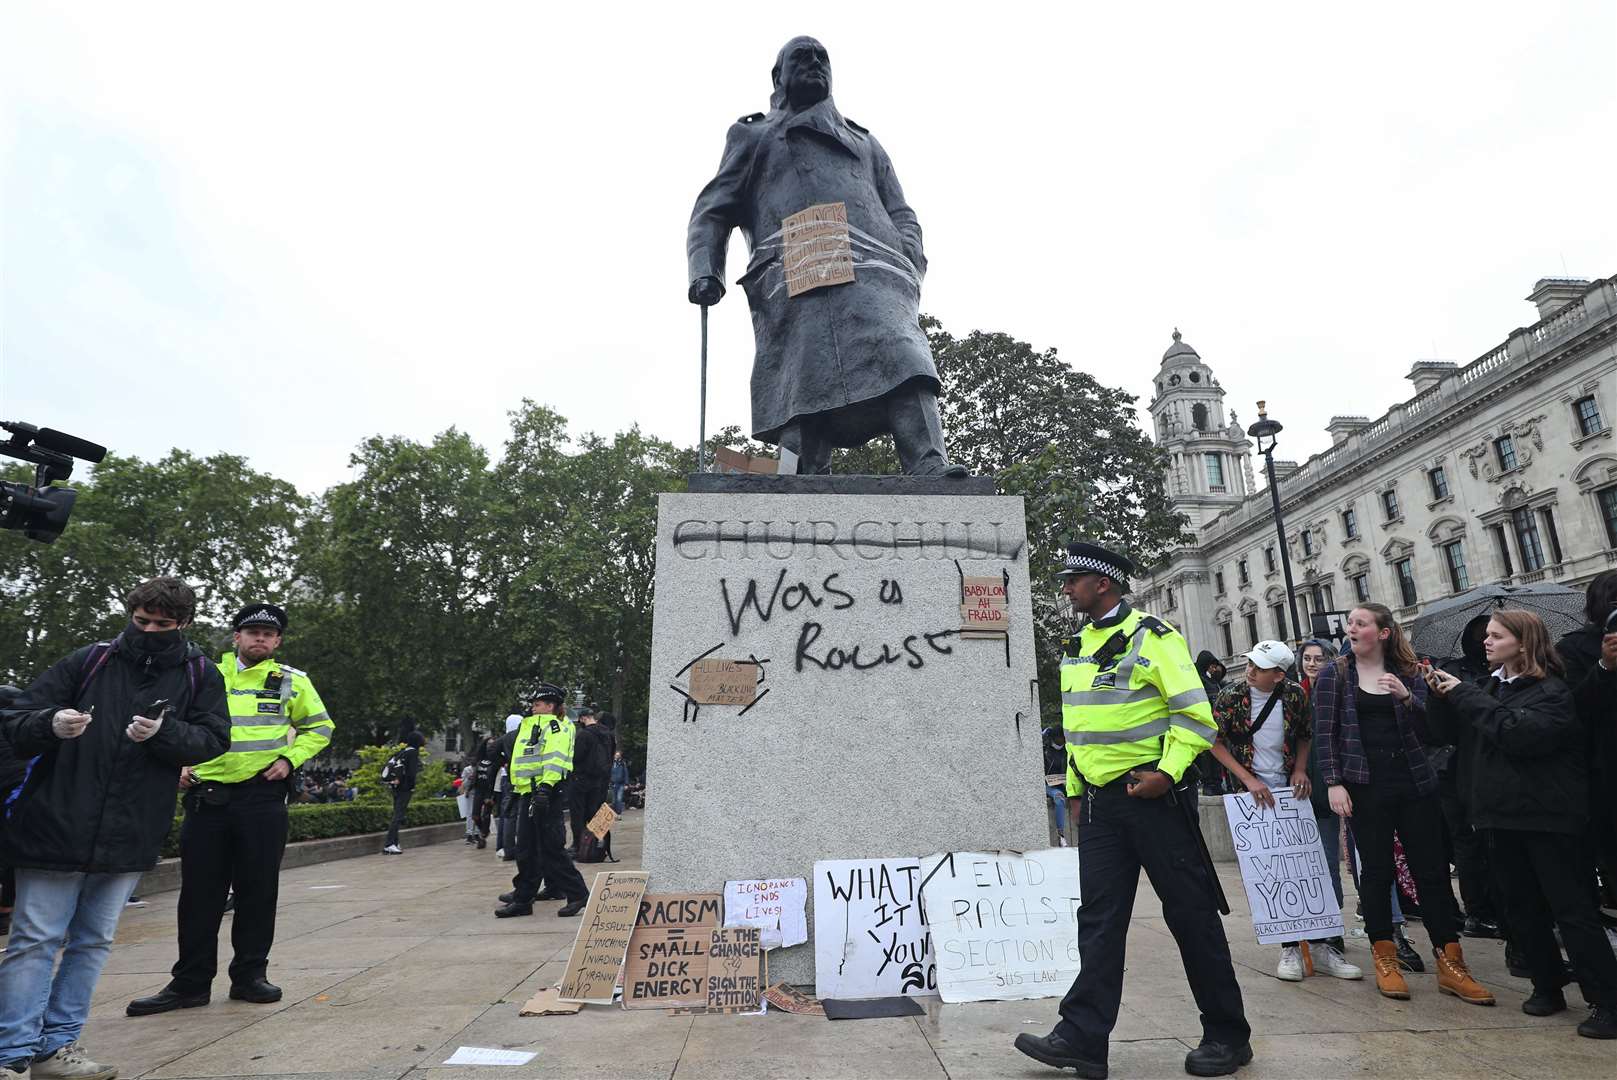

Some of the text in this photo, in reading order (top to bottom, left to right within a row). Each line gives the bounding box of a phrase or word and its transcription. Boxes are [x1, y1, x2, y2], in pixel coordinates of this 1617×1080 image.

[673, 519, 1022, 561] CHURCHILL
[964, 584, 1006, 598] BABYLON
[968, 609, 1002, 621] FRAUD
[1234, 789, 1300, 822] WE
[1234, 818, 1320, 852] STAND
[973, 859, 1045, 888] END
[1251, 850, 1325, 882] WITH
[826, 863, 920, 905] WHAT
[600, 888, 640, 903] QUANDARY
[754, 890, 779, 905] ENDS
[1255, 876, 1326, 919] YOU
[595, 903, 629, 915] UNJUST
[635, 899, 719, 926] RACISM
[952, 896, 1081, 932] RACIST
[589, 915, 633, 933] ASSAULT
[585, 931, 627, 949] LYNCHING
[711, 927, 760, 943] BE THE
[639, 940, 705, 960] SMALL
[709, 942, 759, 958] CHANGE
[943, 938, 1055, 970] SECTION
[577, 967, 618, 985] TYRANNY
[647, 961, 689, 978] DICK
[559, 983, 592, 999] WHY?
[632, 977, 704, 999] ENERGY
[708, 975, 757, 992] SIGN THE
[707, 988, 760, 1006] PETITION
